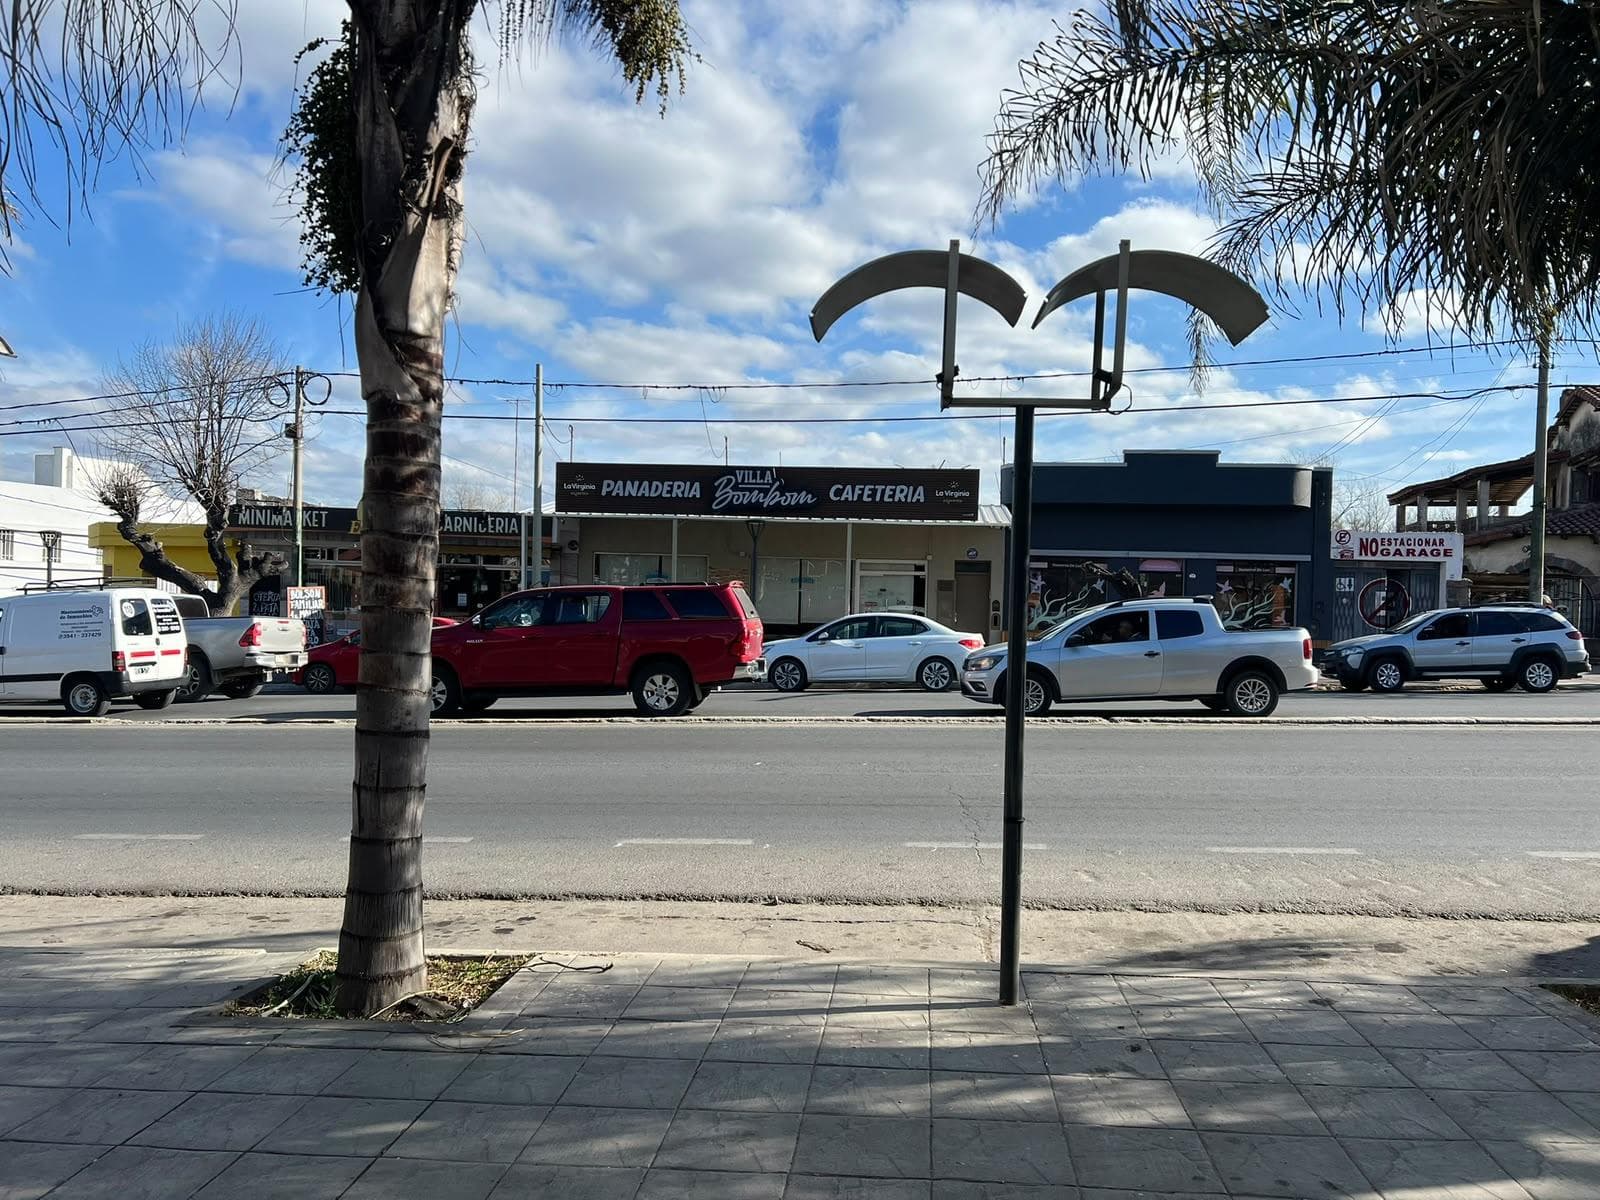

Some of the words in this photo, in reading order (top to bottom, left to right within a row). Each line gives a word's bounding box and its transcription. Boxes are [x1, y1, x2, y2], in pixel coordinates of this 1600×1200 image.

[735, 469, 773, 483] VILLA
[601, 479, 701, 498] PANADERIA
[829, 484, 925, 503] CAFETERIA
[238, 508, 329, 528] MINIMAKET
[1359, 537, 1379, 557] NO
[1380, 537, 1445, 547] ESTACIONAR
[1380, 548, 1454, 558] GARAGE
